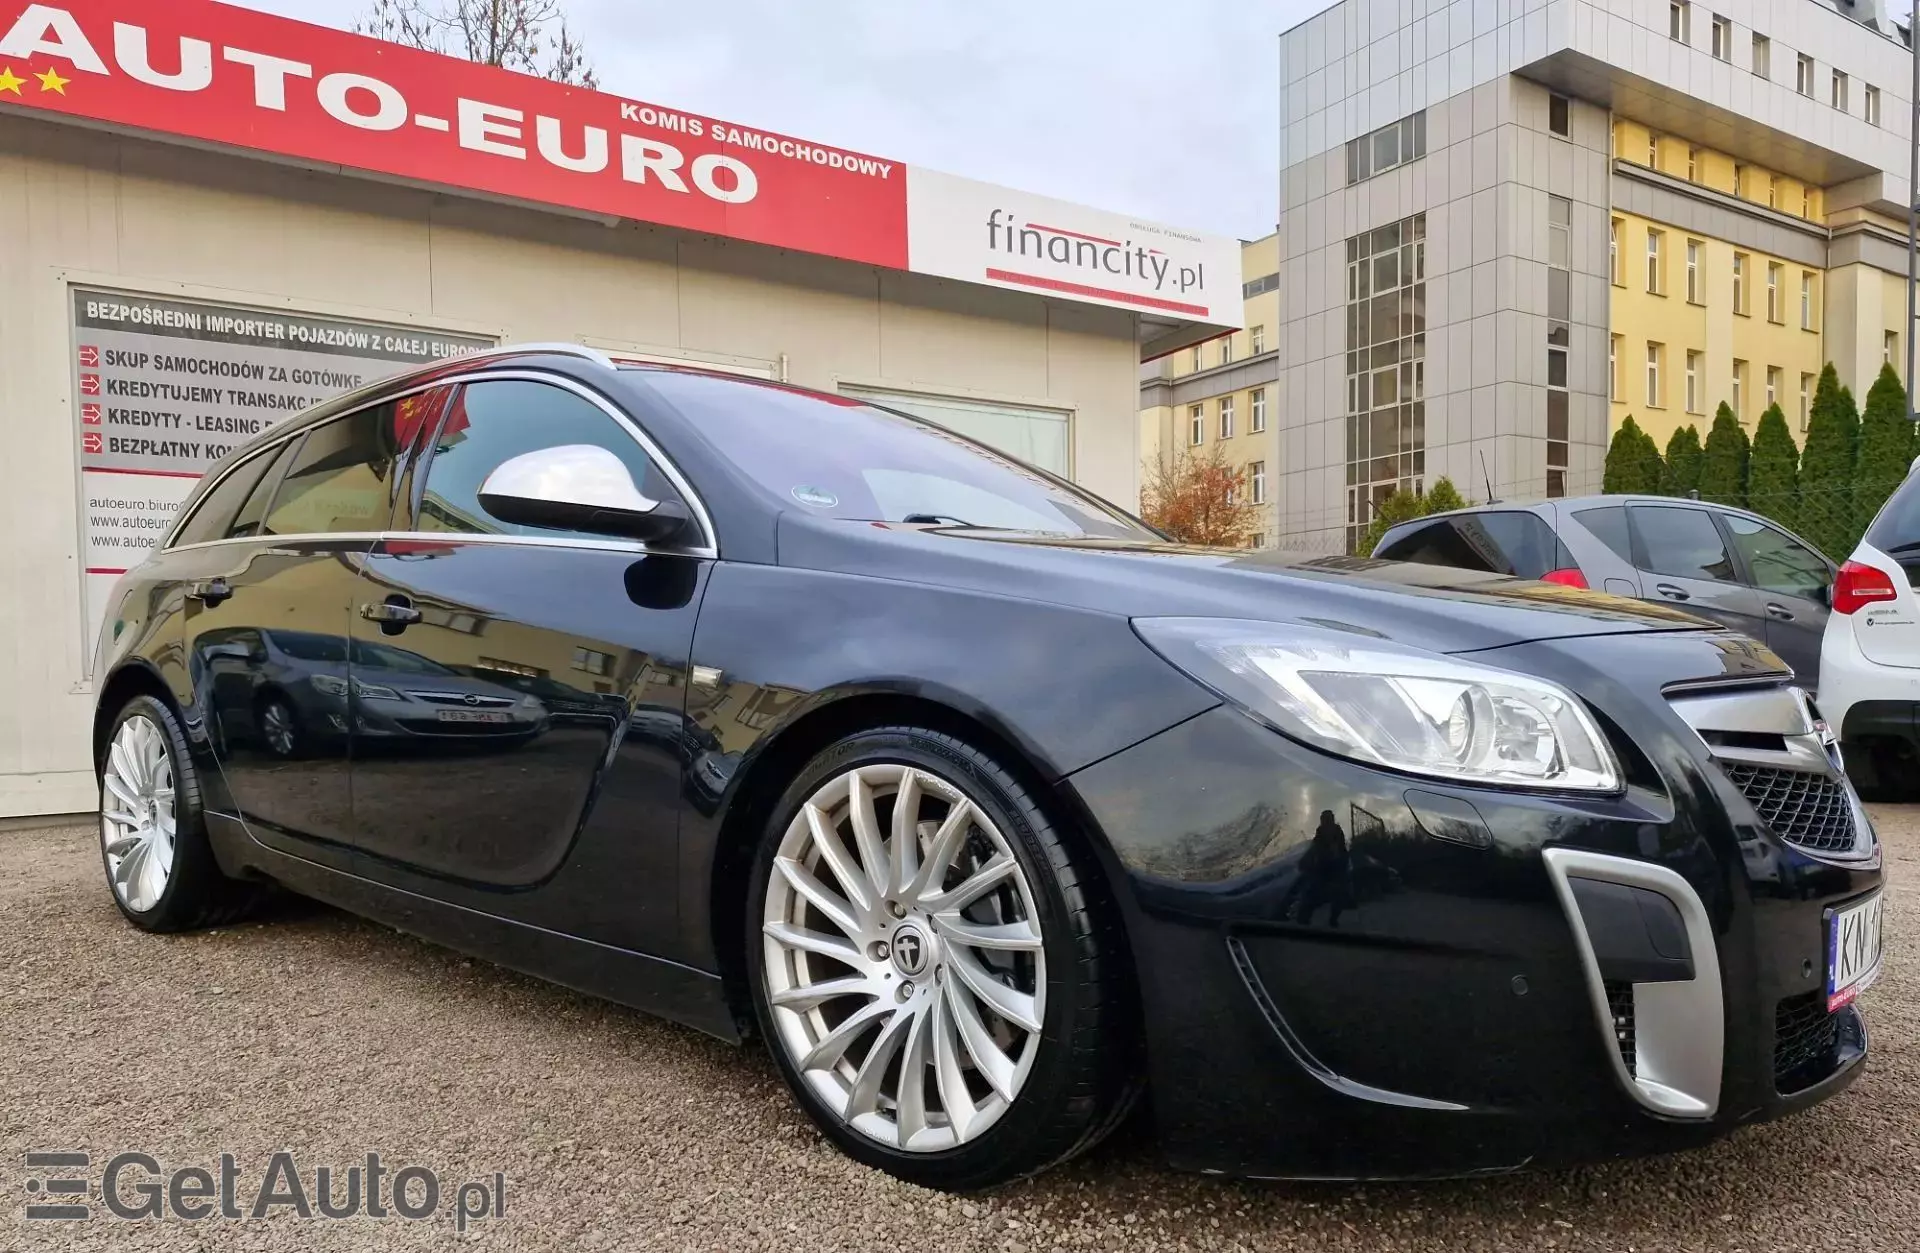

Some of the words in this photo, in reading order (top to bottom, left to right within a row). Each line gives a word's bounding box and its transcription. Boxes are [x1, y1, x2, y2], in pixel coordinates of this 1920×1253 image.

[0, 3, 758, 204] AUTO-EURO
[620, 102, 704, 137] KOMIS
[711, 124, 892, 180] SAMOCHODOWY
[986, 208, 1205, 293] financity.pl
[86, 301, 202, 330] BEZPOŚREDNI
[206, 315, 285, 340] IMPORTER
[288, 325, 368, 349] POJAZDÓW
[372, 335, 382, 350] Z
[384, 337, 428, 356] CAŁEJ
[431, 342, 482, 358] EURO
[105, 350, 149, 369] SKUP
[153, 354, 264, 380] SAMOCHODÓW
[268, 367, 288, 383] ZA
[106, 378, 224, 405] KREDYTUJEMY
[108, 408, 182, 428] KREDYTY
[195, 416, 260, 435] LEASING
[109, 437, 201, 459] BEZPŁATNY
[91, 535, 158, 548] www.autoe
